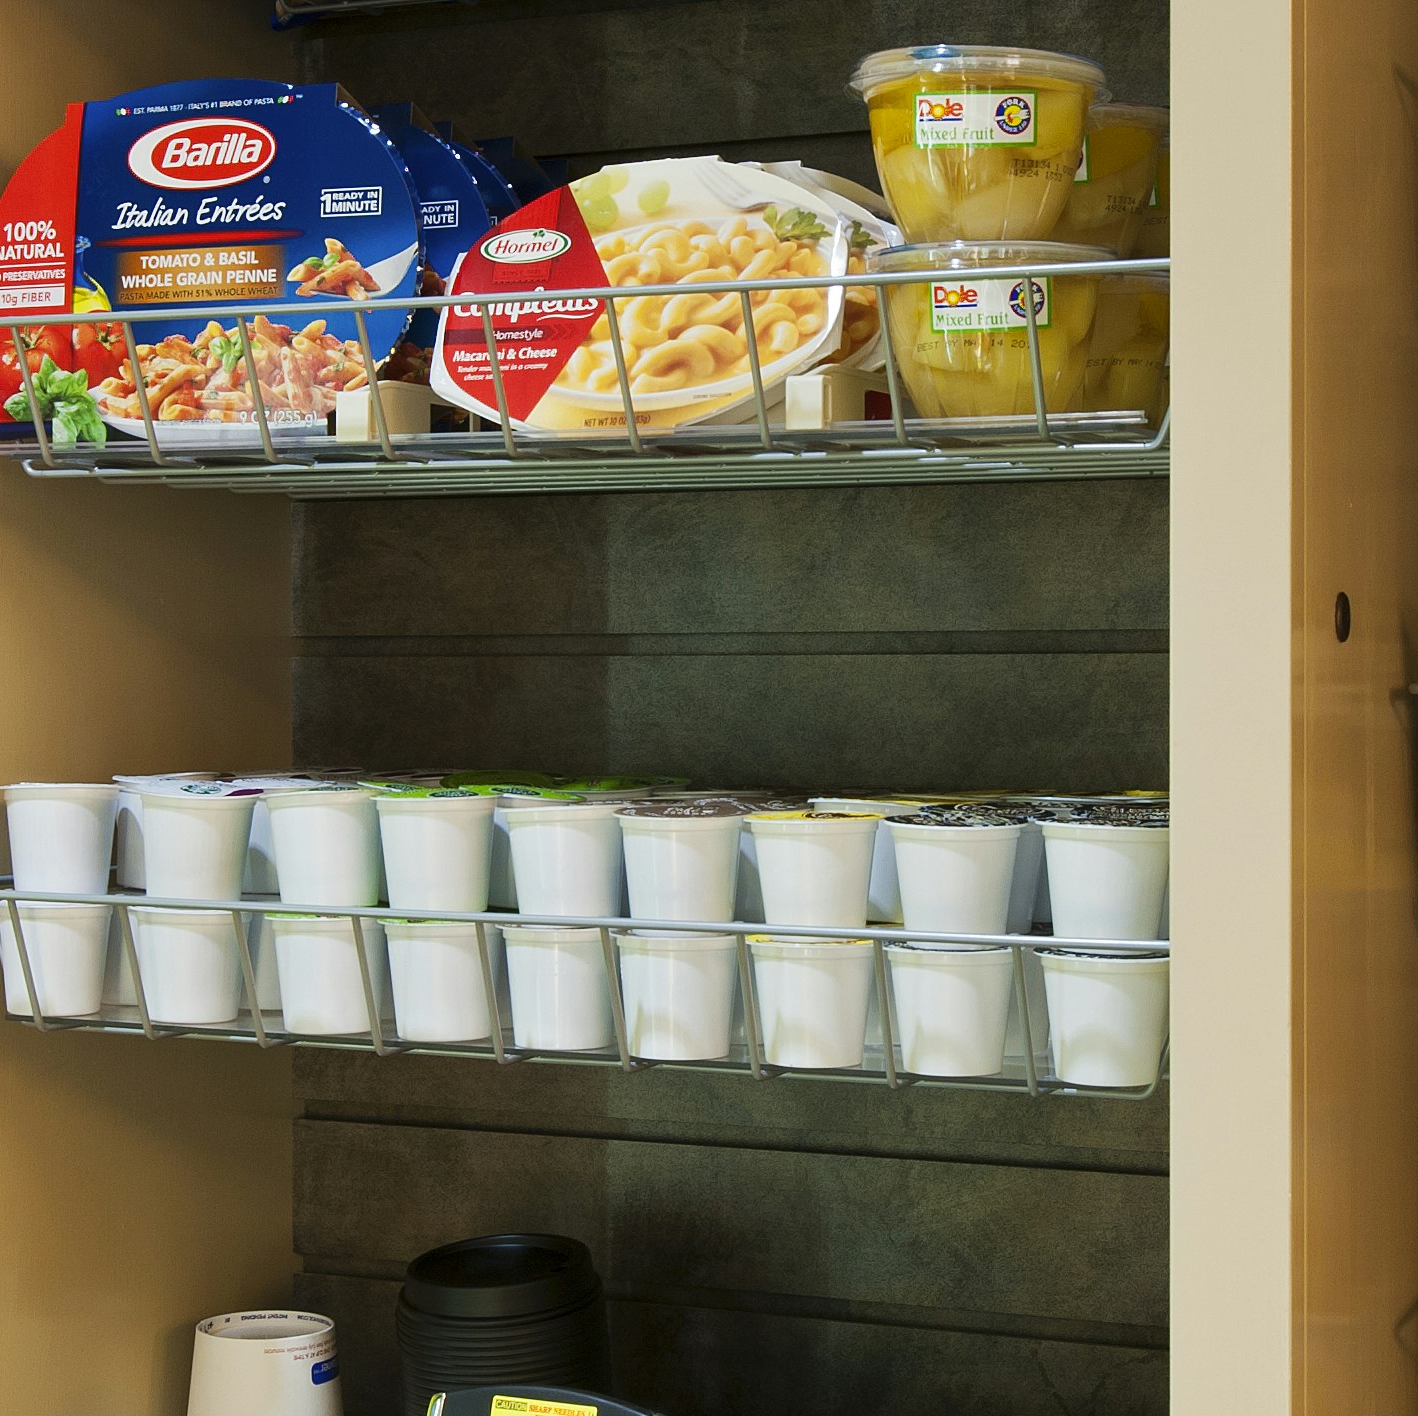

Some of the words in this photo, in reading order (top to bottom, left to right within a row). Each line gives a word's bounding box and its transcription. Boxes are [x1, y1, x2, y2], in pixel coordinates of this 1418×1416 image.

[918, 98, 964, 120] Dole
[920, 127, 957, 141] Mixed
[962, 127, 994, 140] Fruit
[161, 133, 263, 169] Barilla
[333, 192, 363, 202] READY
[367, 191, 378, 200] IN
[111, 197, 189, 231] Italian
[196, 194, 287, 226] Entrées
[331, 199, 379, 213] MINUTE
[3, 220, 56, 242] 100%
[494, 237, 558, 255] Hormel
[140, 253, 201, 269] TOMATO
[204, 252, 215, 266] &
[218, 250, 259, 266] BASIL
[0, 269, 65, 281] PRESERVATIVES
[121, 273, 173, 288] WHOLE
[176, 270, 223, 286] GRAIN
[226, 268, 277, 284] PENNE
[1, 293, 18, 306] 10g
[21, 292, 51, 304] FIBER
[120, 291, 143, 301] PASTA
[146, 291, 170, 300] MADE
[172, 290, 193, 298] WITH
[195, 289, 213, 298] 51%
[214, 287, 246, 297] WHOLE
[248, 286, 279, 296] WHEAT
[933, 285, 978, 305] Dole
[936, 313, 972, 327] Mixed
[978, 312, 1010, 326] Fruit
[493, 329, 544, 341] Homestyle
[507, 349, 517, 361] &
[518, 347, 557, 360] Cheese
[496, 1400, 527, 1412] CAUTION
